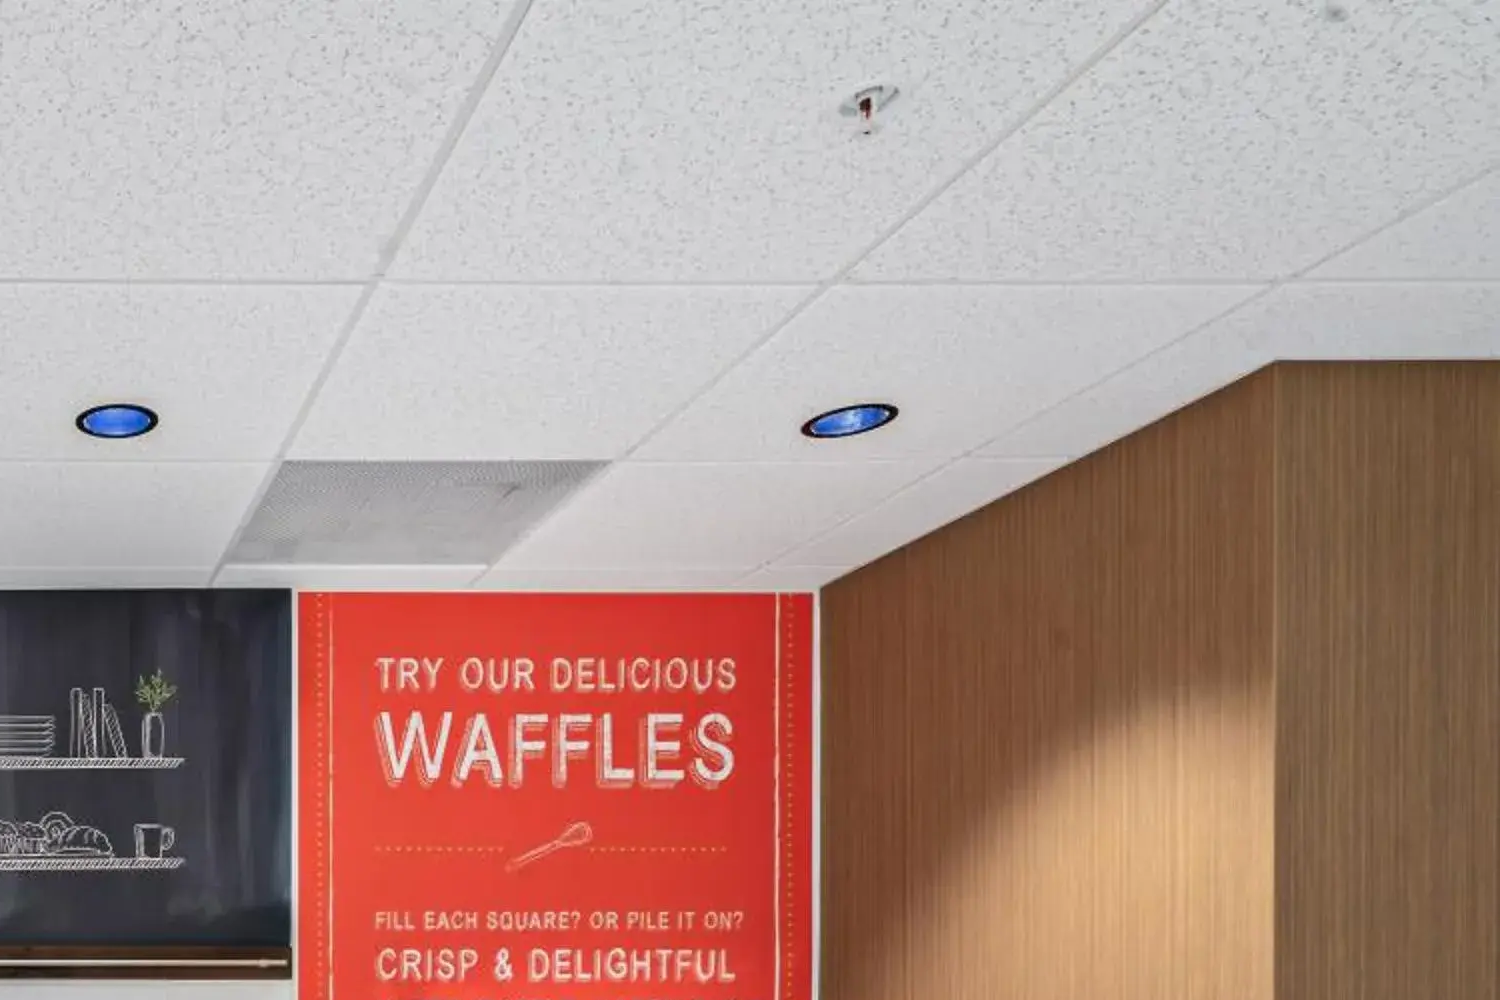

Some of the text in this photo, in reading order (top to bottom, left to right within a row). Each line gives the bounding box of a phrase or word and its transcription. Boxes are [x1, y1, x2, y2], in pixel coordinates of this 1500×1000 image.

[375, 656, 737, 693] TRY OUR DELICIOUS
[374, 710, 736, 790] WAFFLES
[375, 911, 744, 930] FILL EACH SQUARE? OR PILE IT ON?
[376, 947, 736, 983] CRISP & DELIGHTFUL
